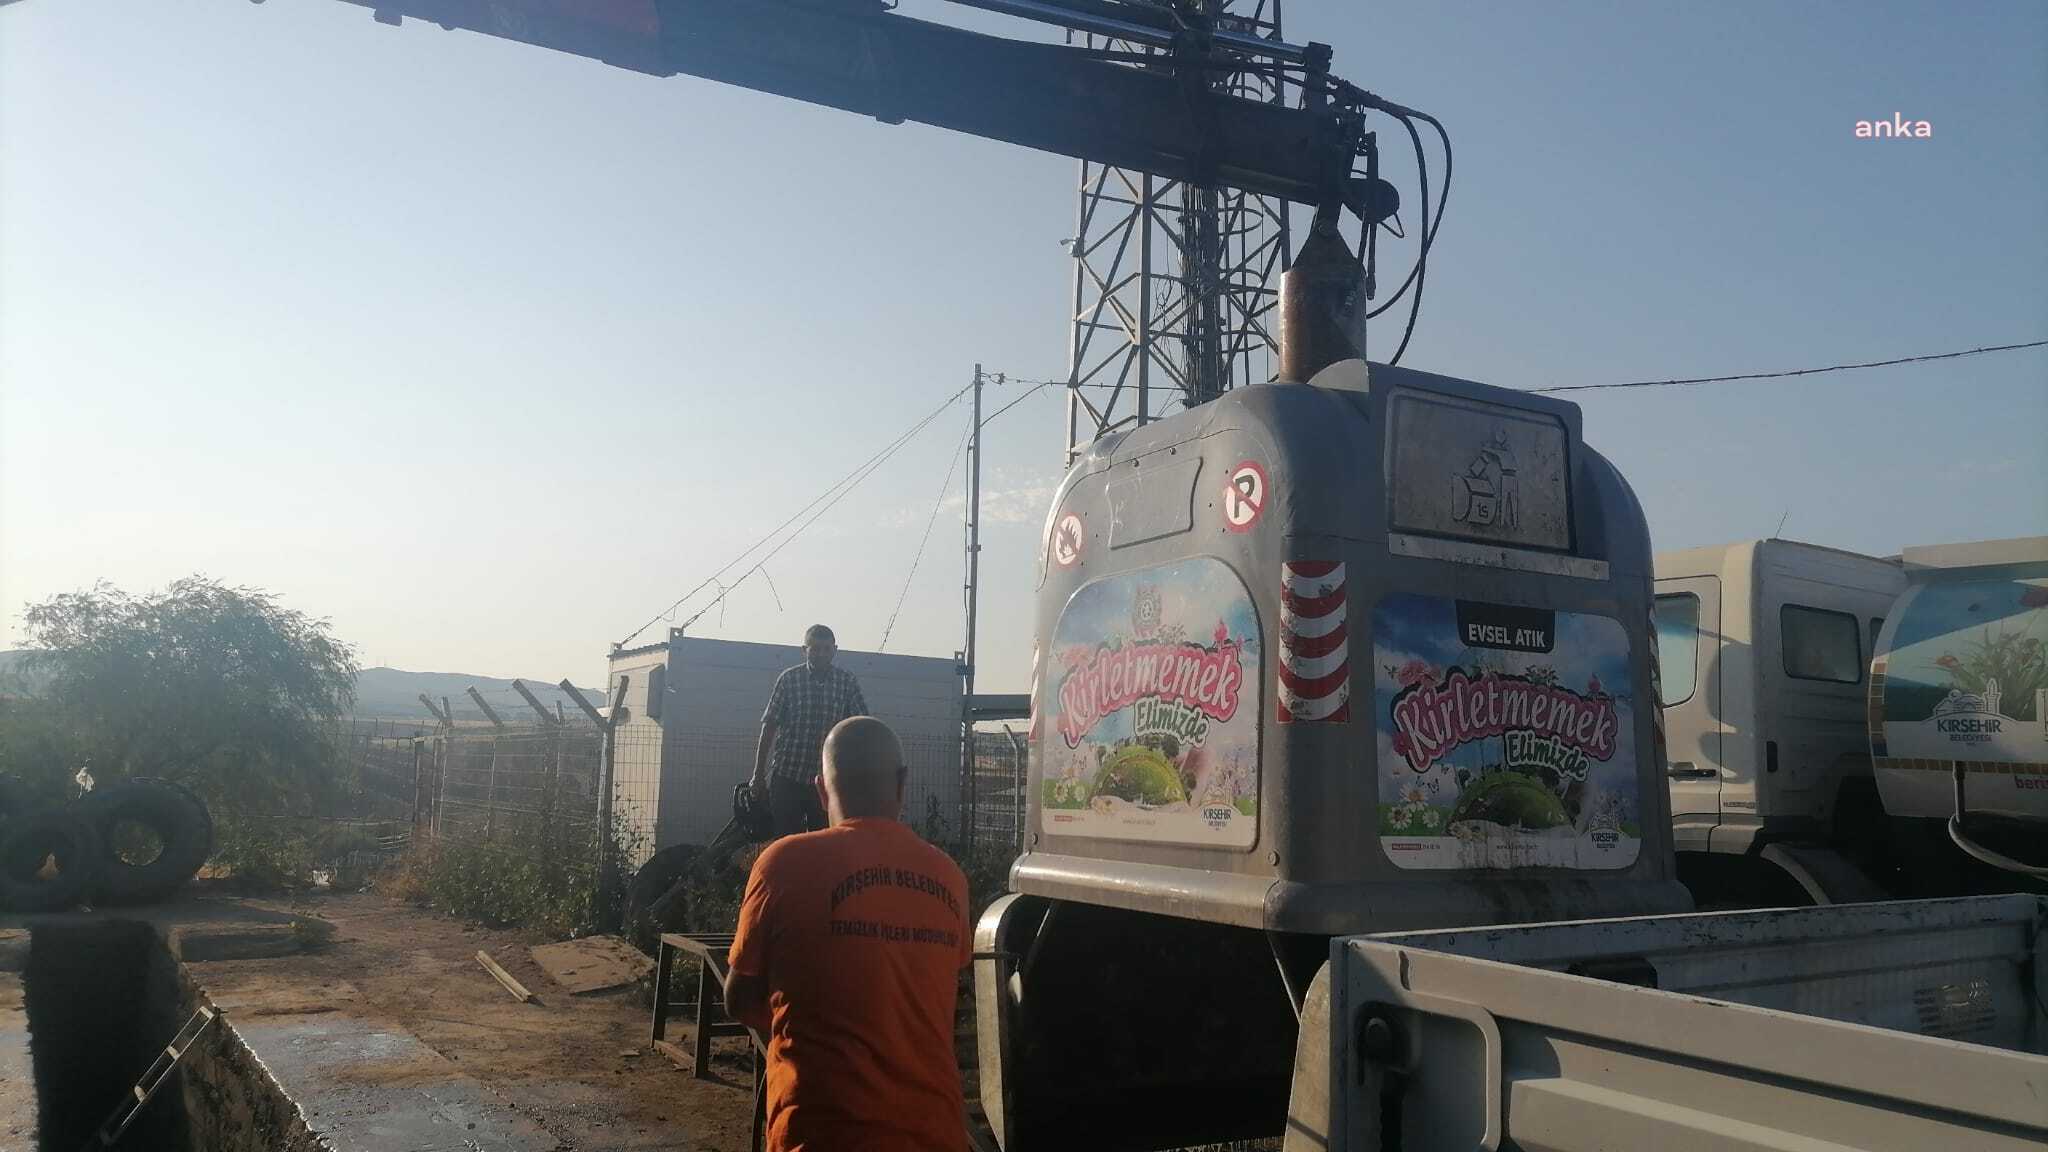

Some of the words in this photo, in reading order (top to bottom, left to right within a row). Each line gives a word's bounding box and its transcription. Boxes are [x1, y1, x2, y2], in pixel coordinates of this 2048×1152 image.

[1468, 623, 1511, 645] EVSEL
[1515, 629, 1547, 648] ATIK
[1062, 653, 1236, 738] Kirletmemek
[1137, 703, 1208, 743] Elimizde
[1400, 681, 1612, 761] Kirletmemek
[1508, 733, 1588, 777] Elimizde
